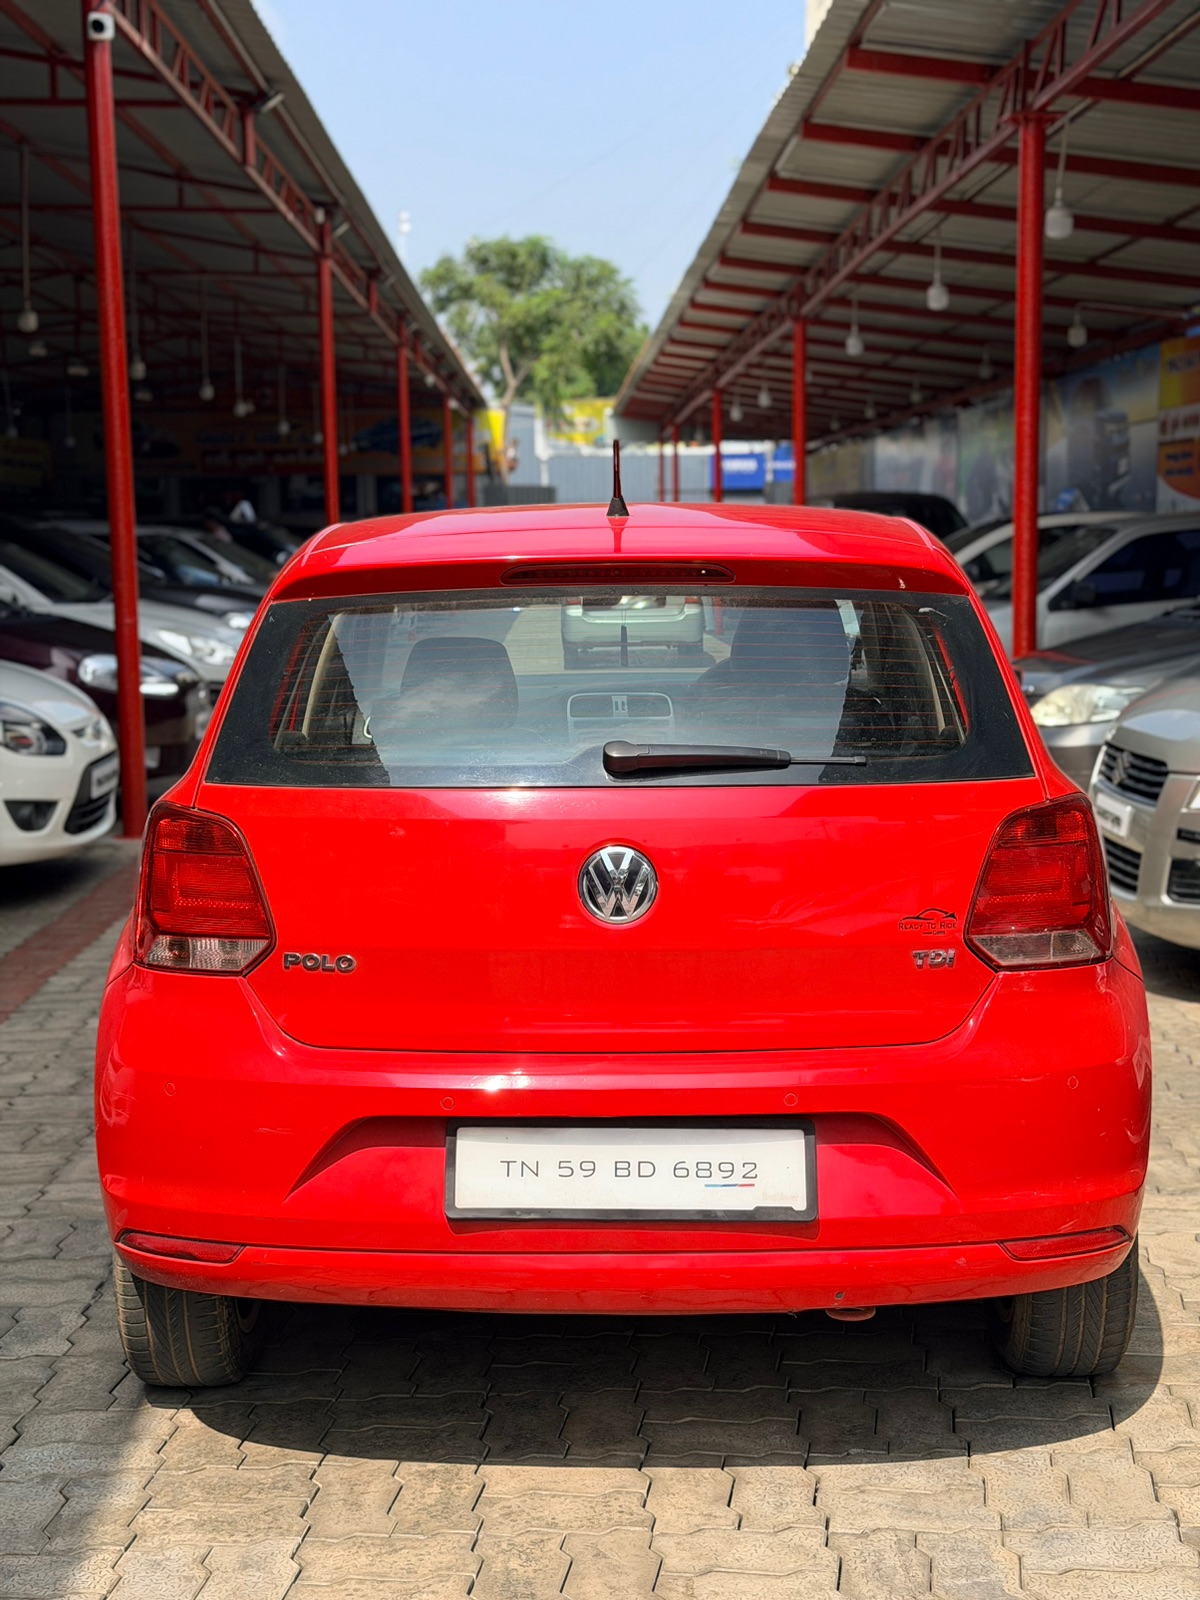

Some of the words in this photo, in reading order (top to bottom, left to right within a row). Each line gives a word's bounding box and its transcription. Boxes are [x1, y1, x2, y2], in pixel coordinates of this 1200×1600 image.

[899, 921, 923, 930] READY
[283, 952, 355, 973] POLO
[913, 949, 955, 968] TDI
[500, 1160, 539, 1178] TN
[558, 1160, 596, 1178] 59
[614, 1160, 656, 1178] BD
[673, 1161, 758, 1179] 6892
